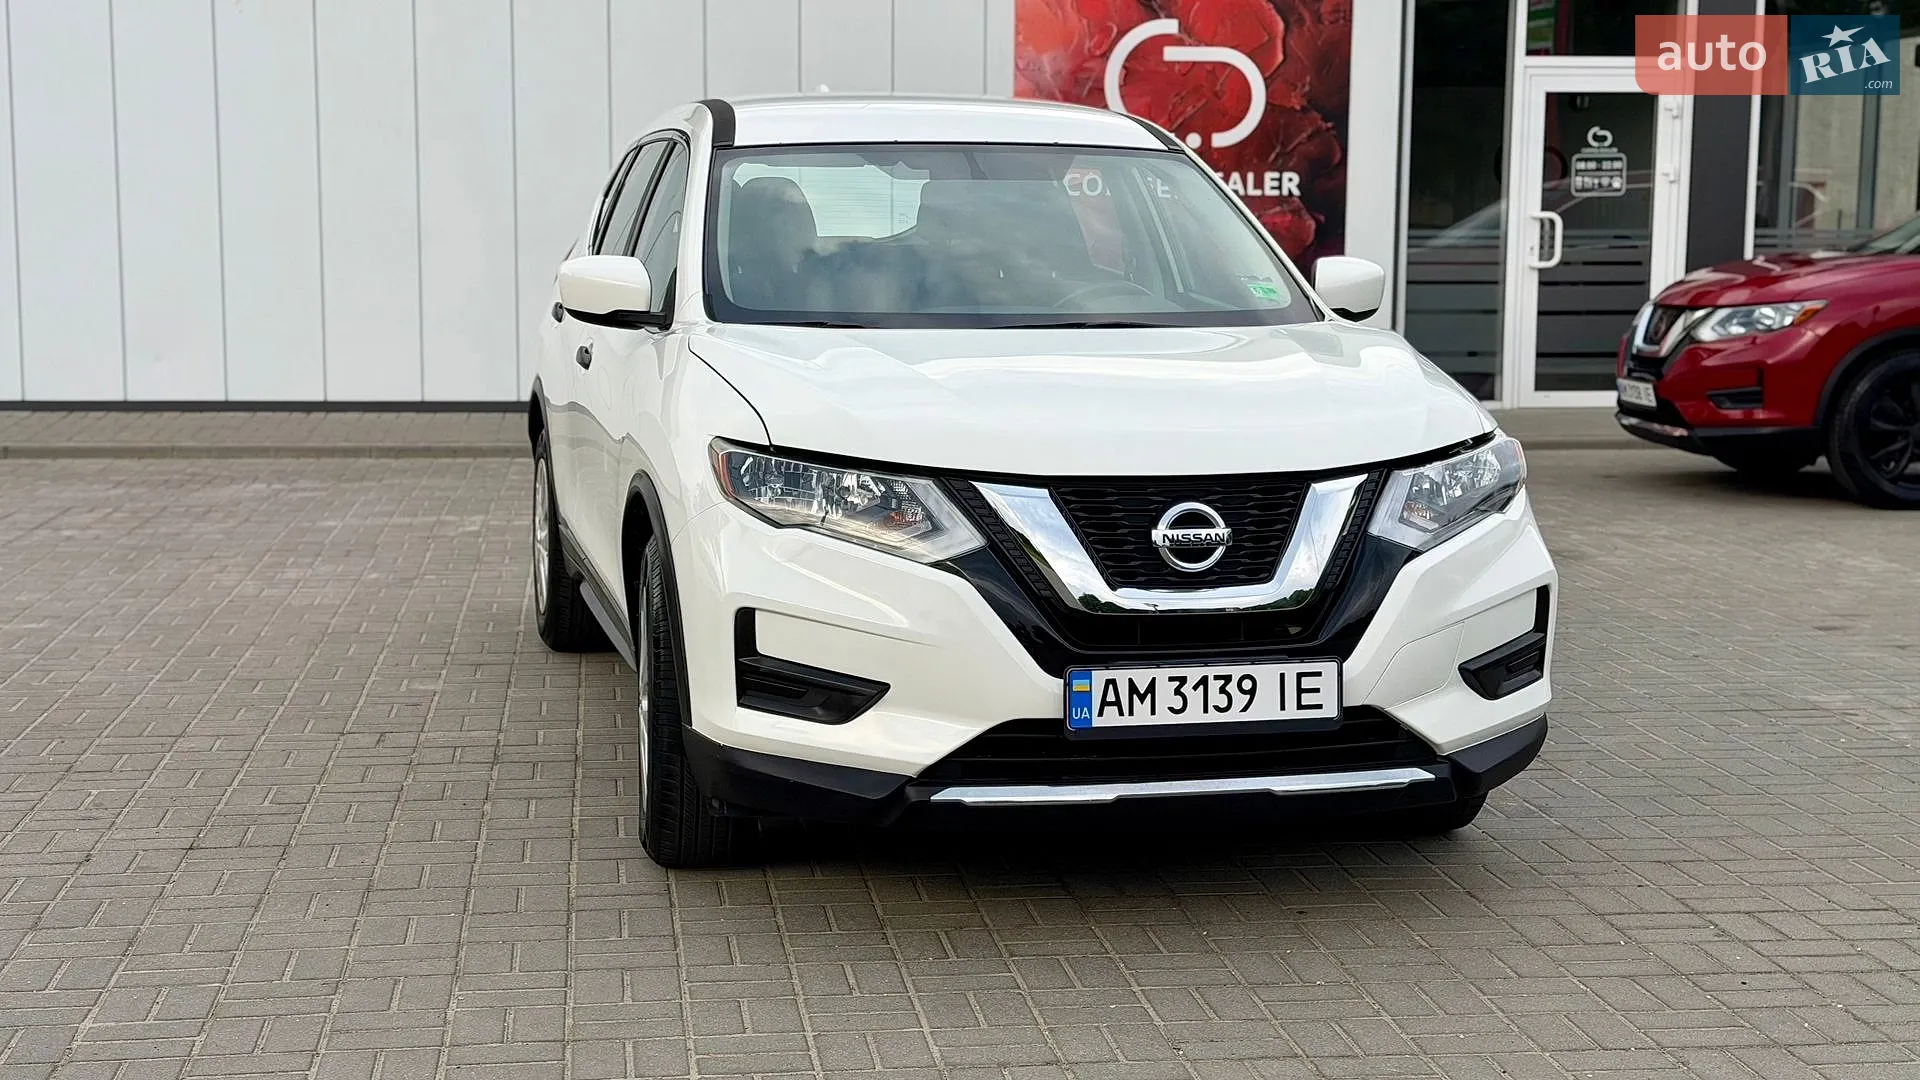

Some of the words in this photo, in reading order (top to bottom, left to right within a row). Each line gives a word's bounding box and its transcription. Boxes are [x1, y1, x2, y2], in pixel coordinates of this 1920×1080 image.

[1162, 533, 1226, 544] NISSAN
[1097, 676, 1157, 718] AM
[1167, 673, 1258, 715] 3139
[1279, 670, 1324, 712] IE
[1072, 706, 1090, 719] UA
